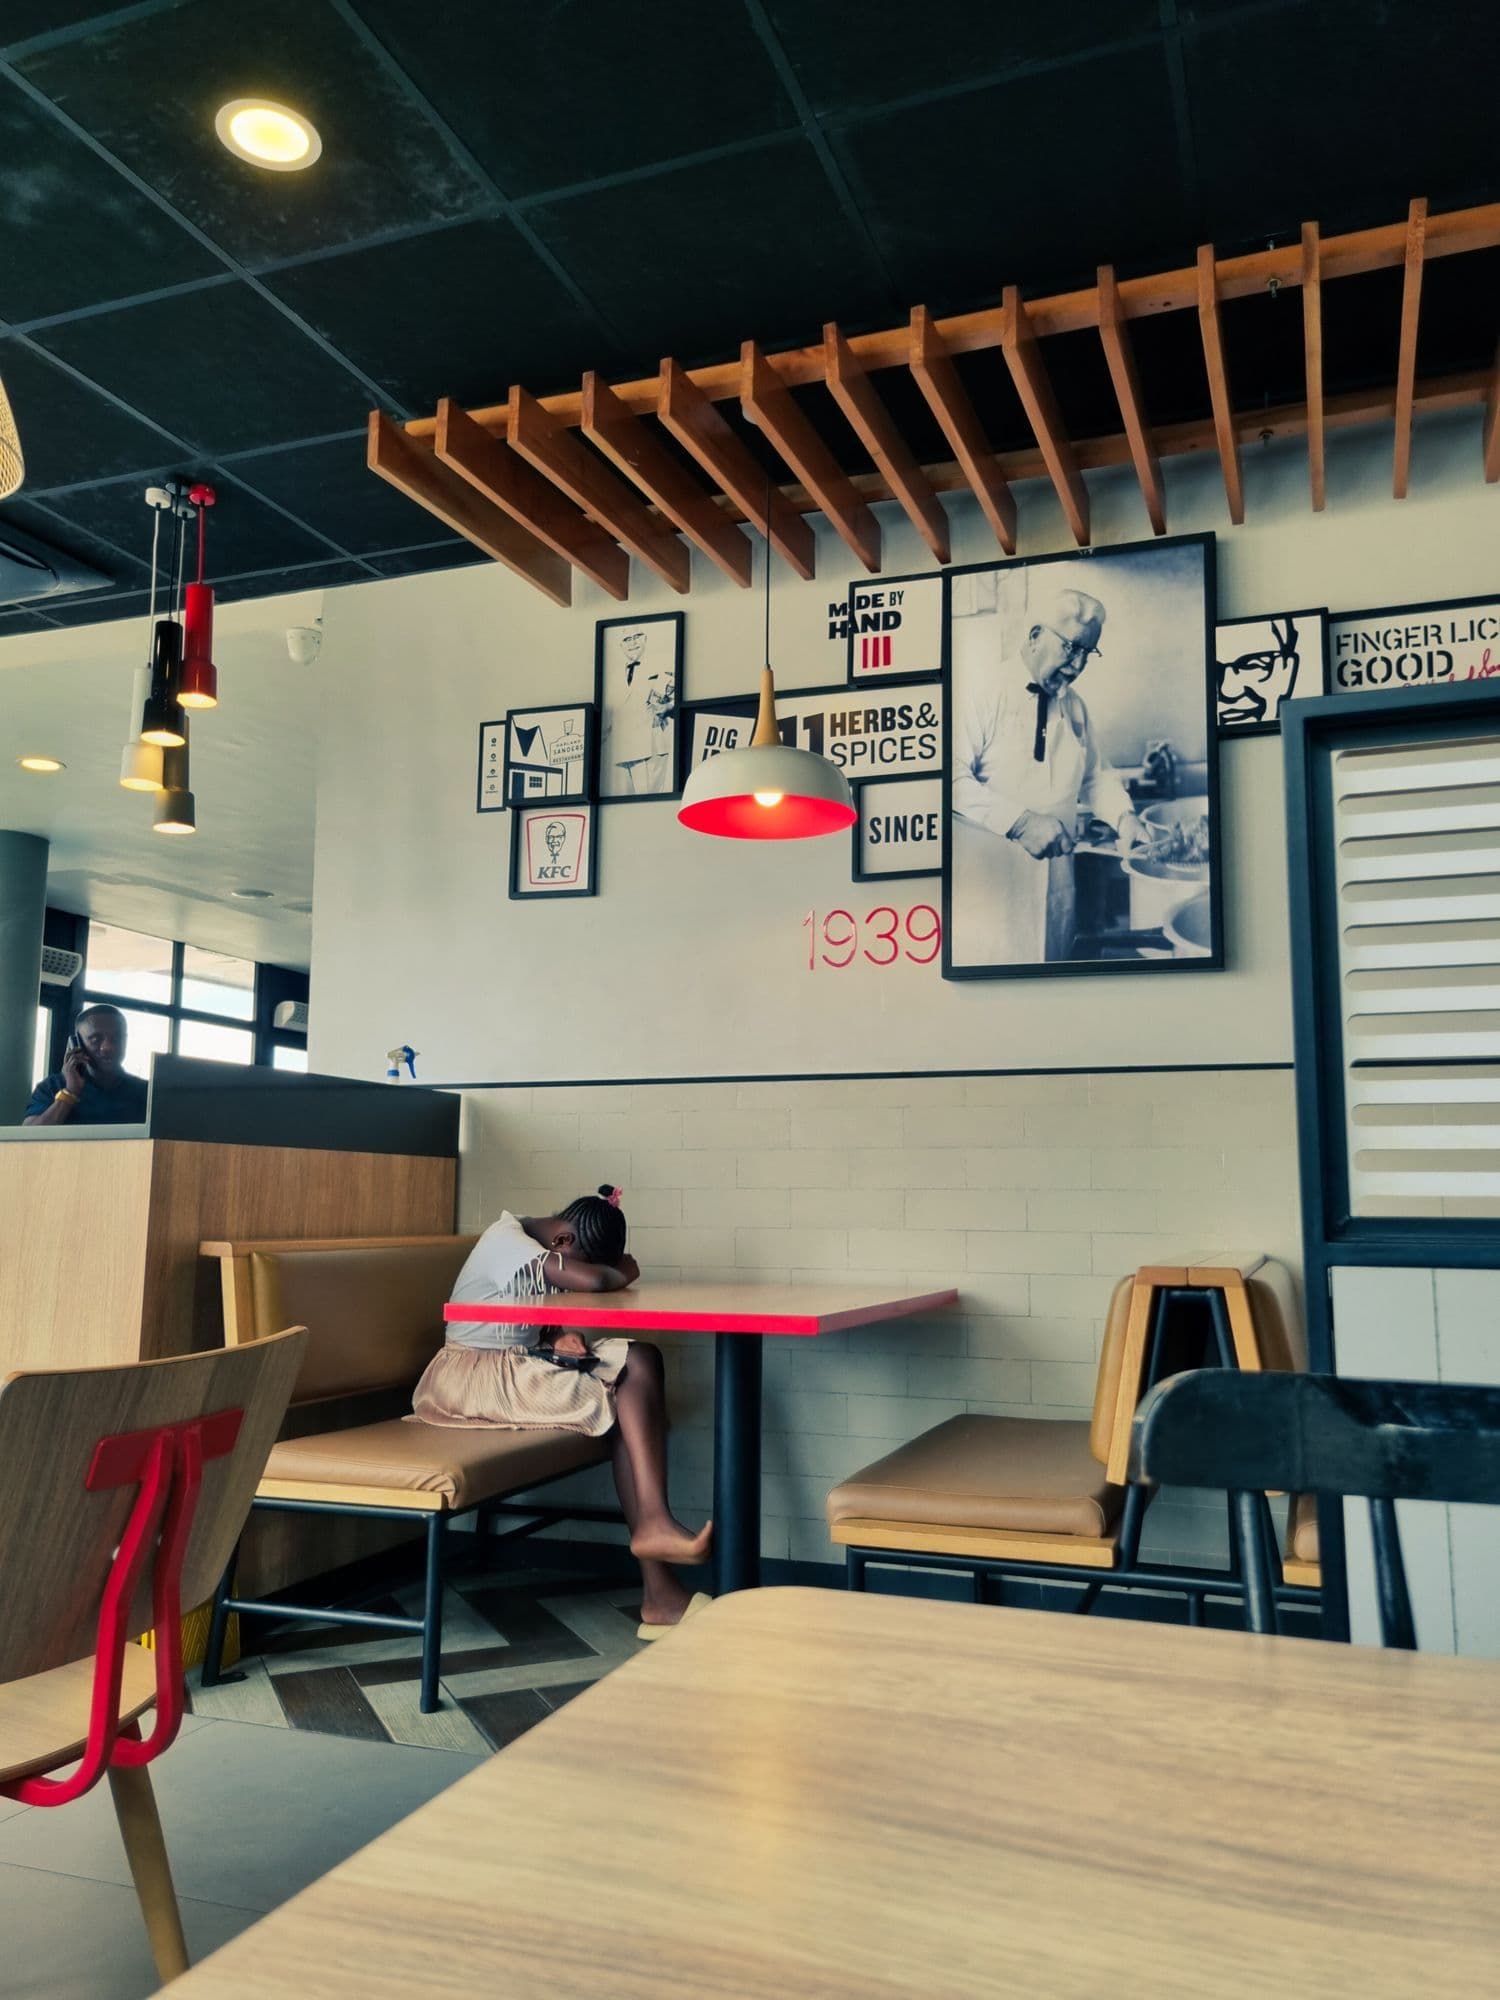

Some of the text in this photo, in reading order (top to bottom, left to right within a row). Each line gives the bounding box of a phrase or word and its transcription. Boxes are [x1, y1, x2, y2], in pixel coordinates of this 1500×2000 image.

[889, 590, 904, 606] BY
[1336, 617, 1500, 656] FINGER LIC
[1337, 650, 1454, 687] GOOD
[705, 726, 738, 749] DIG
[830, 702, 939, 738] HERBS&
[830, 733, 937, 768] SPICES
[869, 813, 938, 844] SINCE
[537, 865, 571, 880] KFC
[803, 905, 941, 970] 1939
